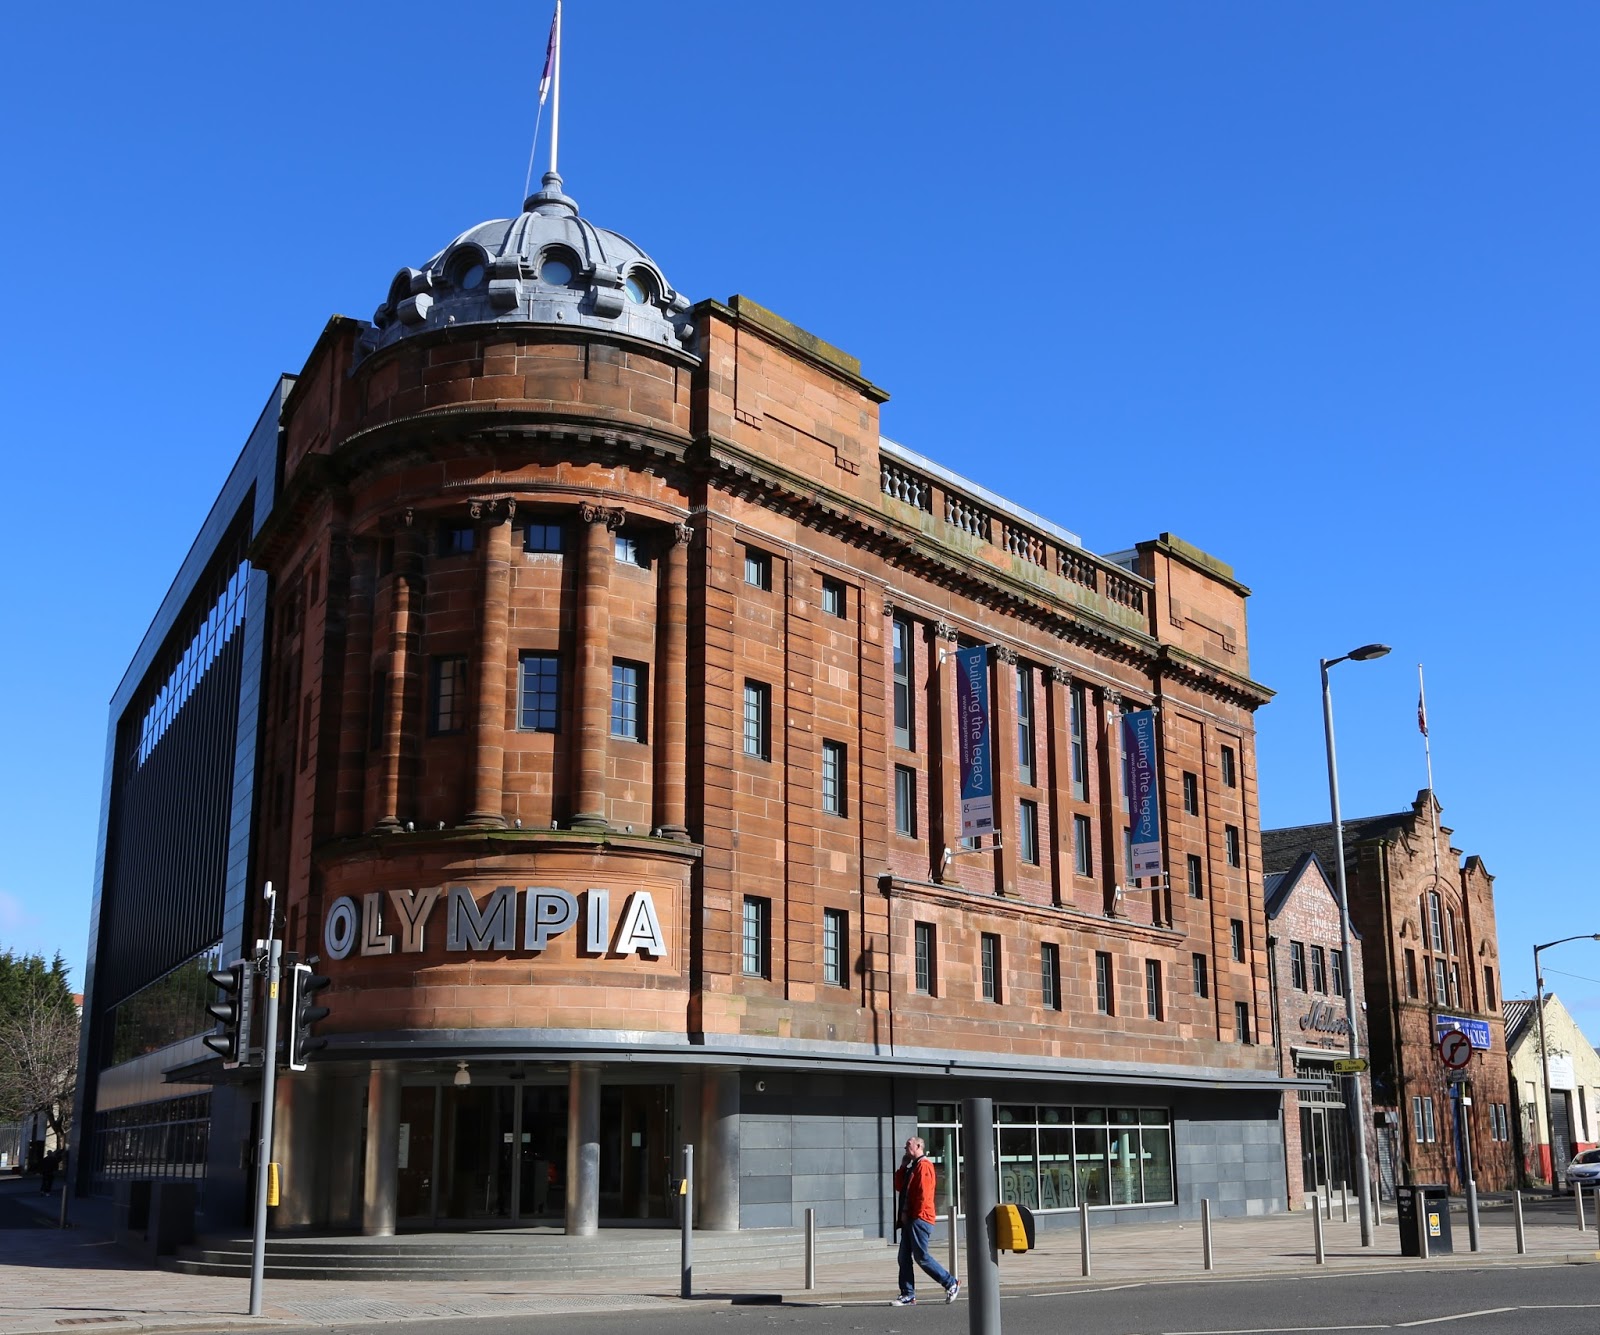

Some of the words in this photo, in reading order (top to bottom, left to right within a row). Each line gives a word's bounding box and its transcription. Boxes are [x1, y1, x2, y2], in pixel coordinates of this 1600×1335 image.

[968, 654, 983, 713] Building
[971, 716, 984, 740] the
[1136, 717, 1150, 769] Building
[970, 742, 985, 791] legacy
[1140, 771, 1151, 793] the
[1140, 795, 1152, 837] legacy
[324, 886, 667, 960] OLYMPIA
[1001, 1167, 1092, 1208] BRARY
